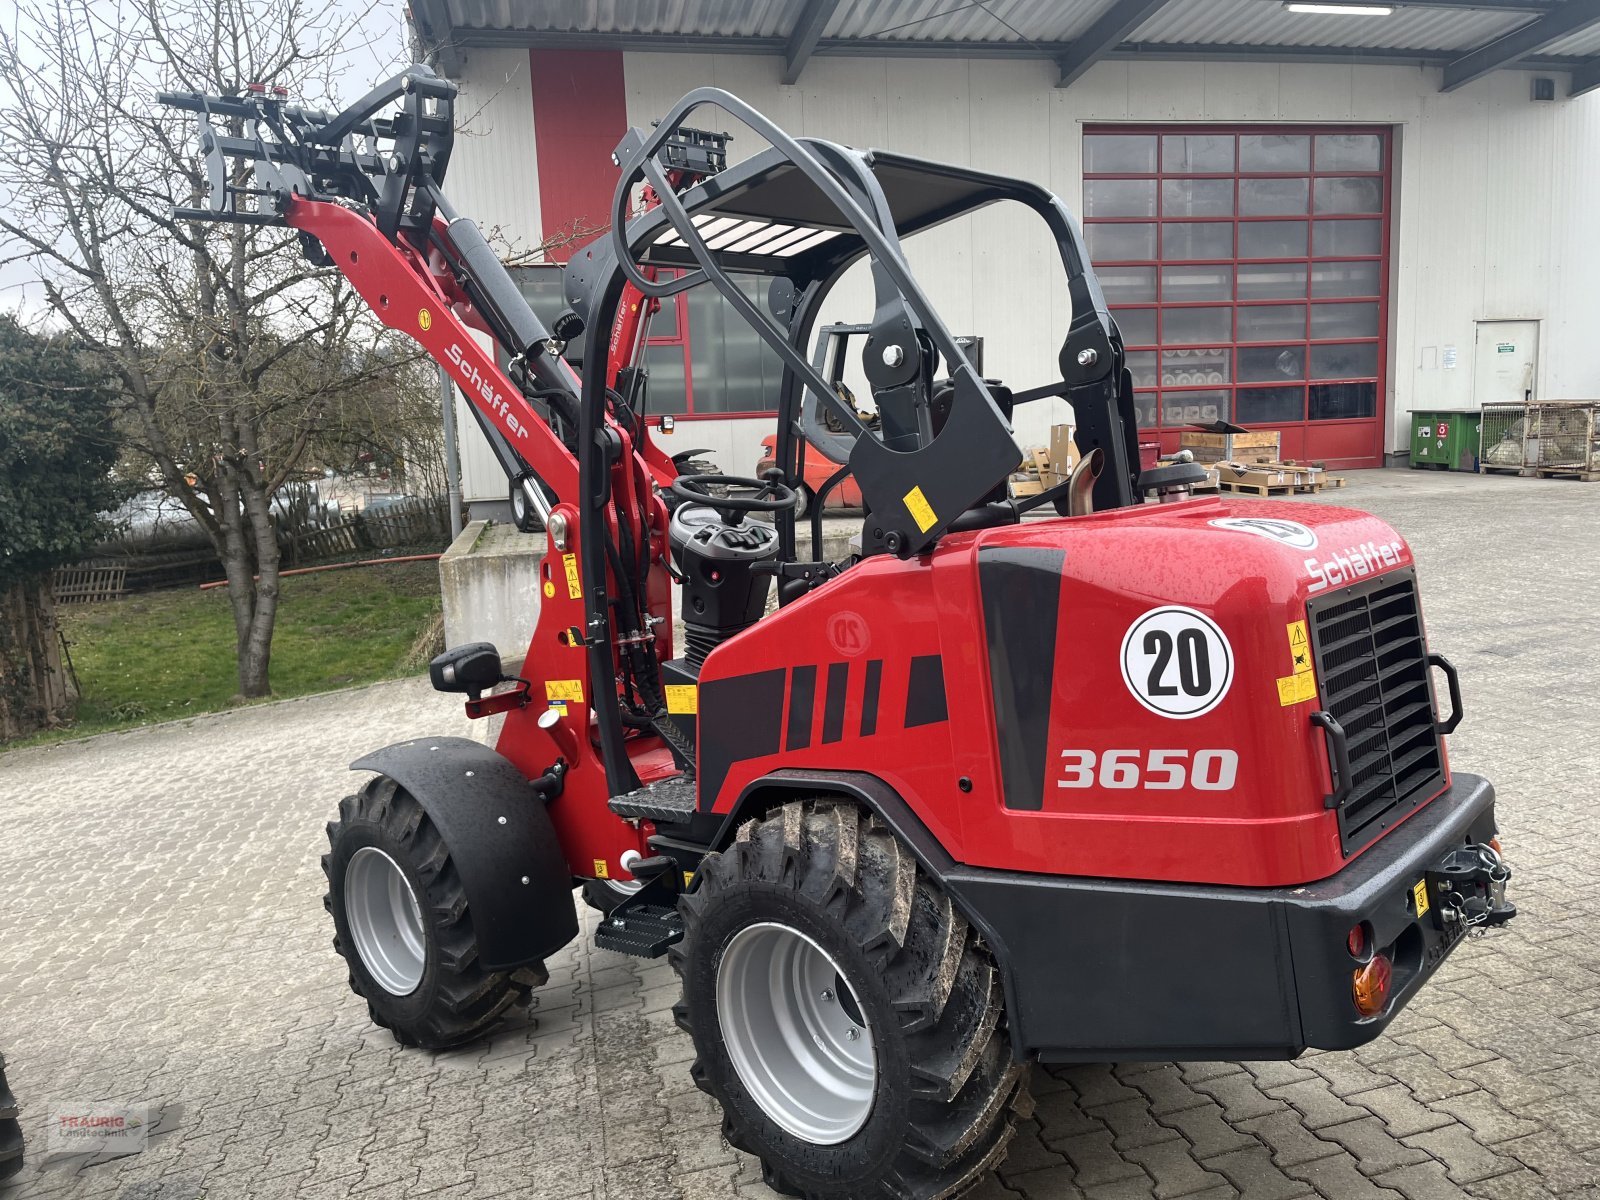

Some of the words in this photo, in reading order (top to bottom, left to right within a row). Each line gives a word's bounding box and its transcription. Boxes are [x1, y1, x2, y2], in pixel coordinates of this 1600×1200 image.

[444, 343, 529, 439] Schäffer
[1304, 541, 1405, 593] Schäffer
[1143, 628, 1212, 697] 20
[1057, 749, 1239, 791] 3650
